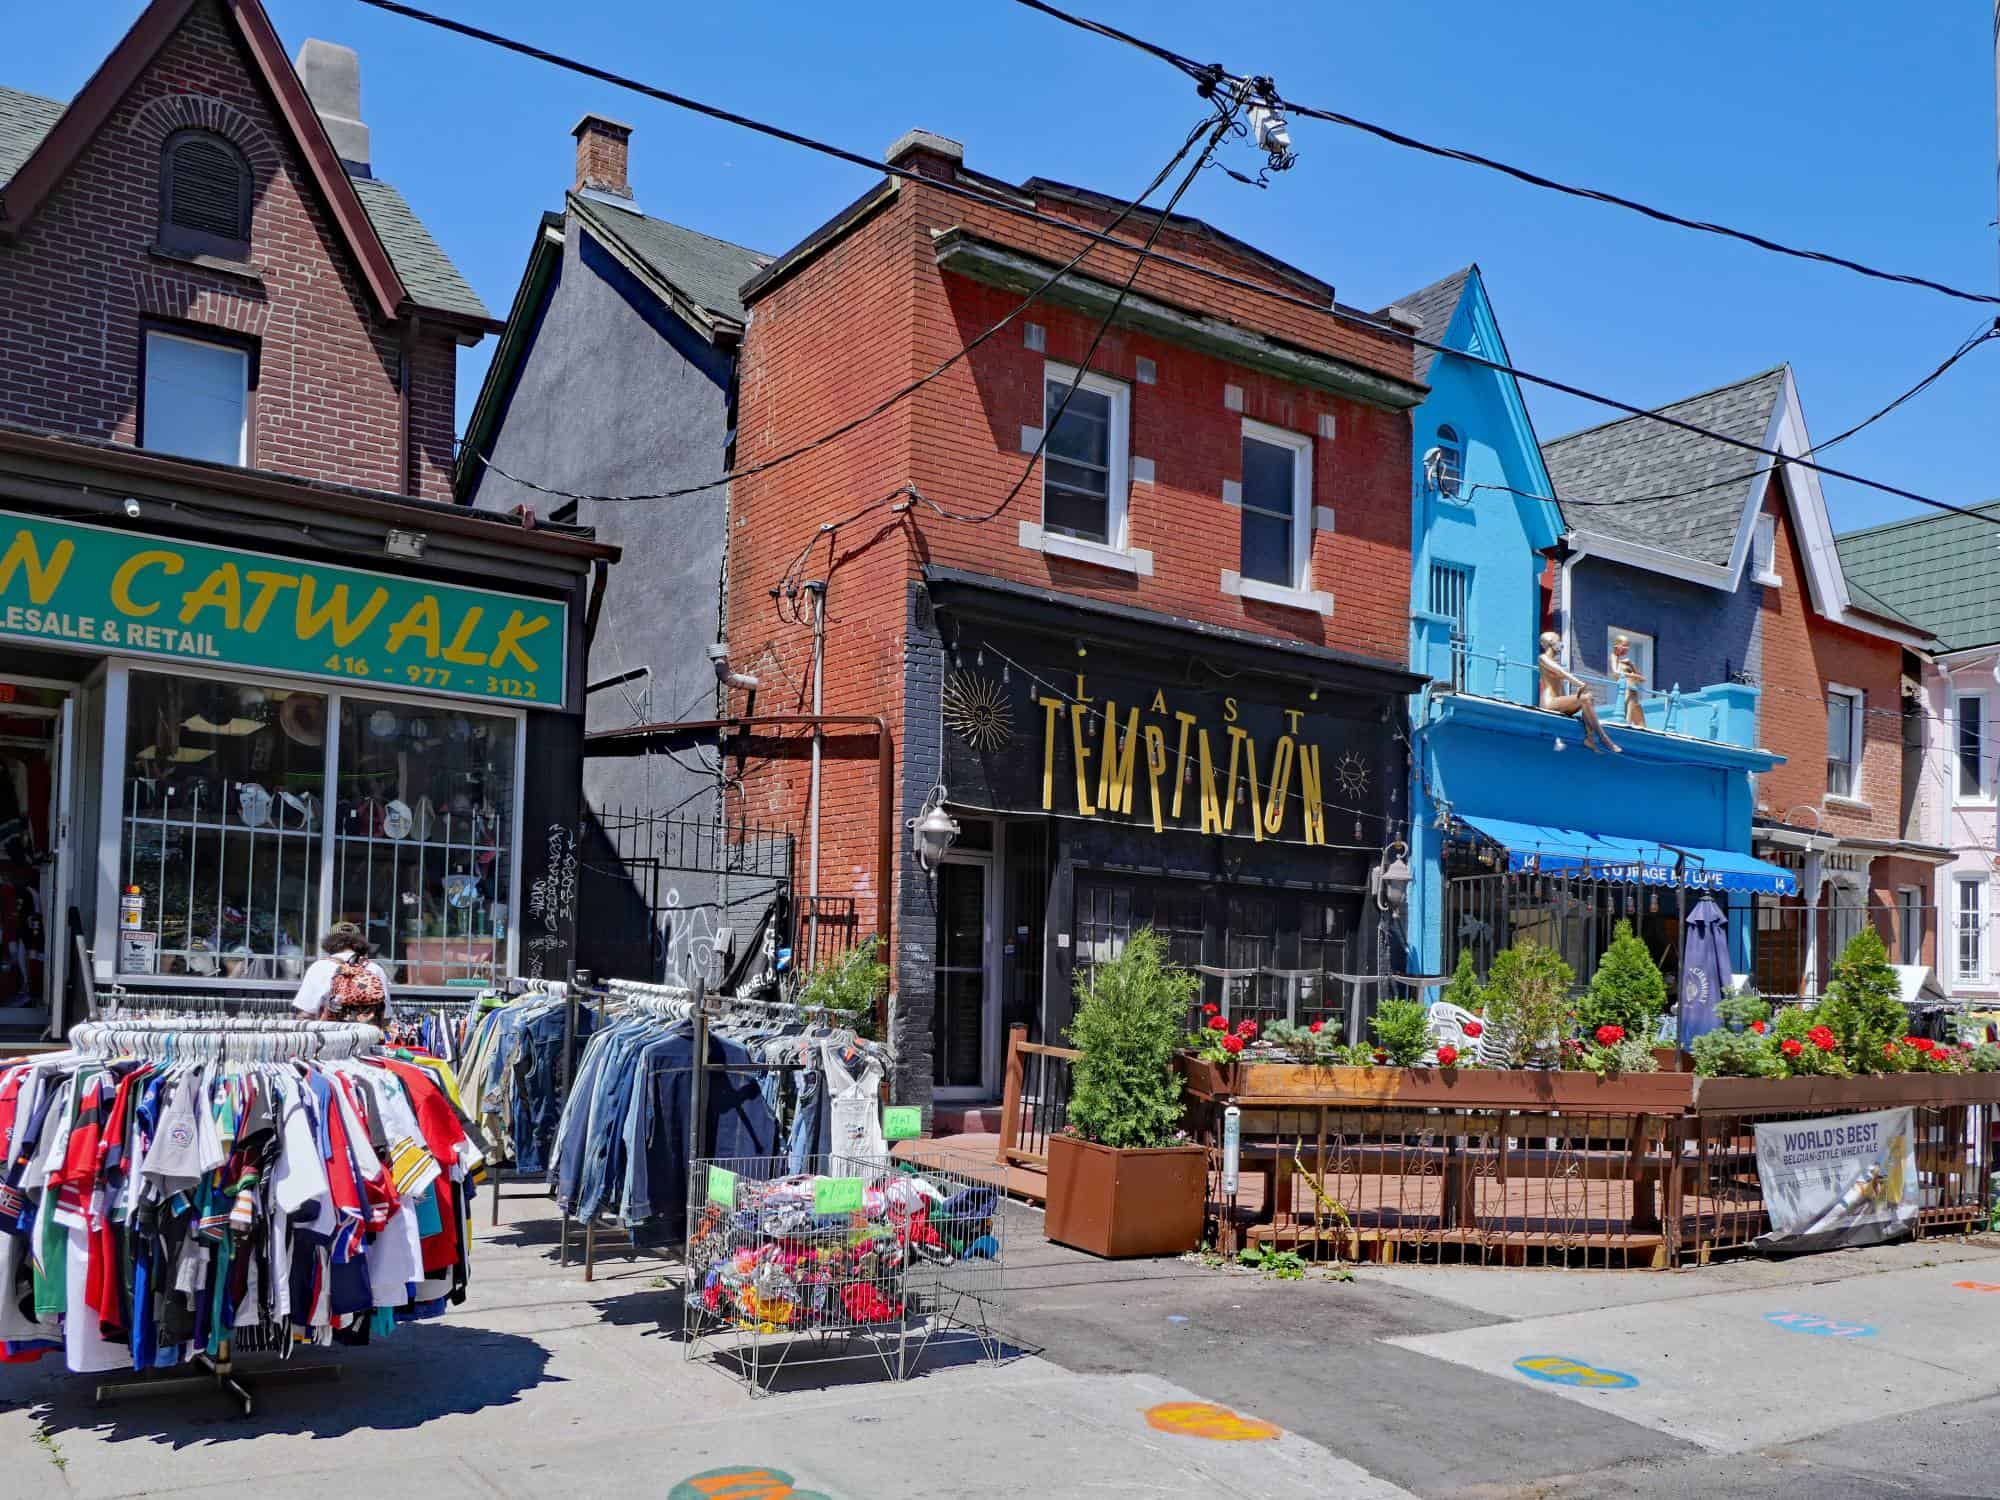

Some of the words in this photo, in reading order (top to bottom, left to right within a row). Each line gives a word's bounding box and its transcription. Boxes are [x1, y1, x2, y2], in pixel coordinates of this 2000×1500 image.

[110, 550, 550, 673] CATWALK
[102, 620, 120, 642] &
[127, 623, 219, 657] RETAIL
[324, 654, 369, 676] 416
[406, 663, 451, 686] 977
[487, 676, 537, 698] 3122
[1076, 673, 1304, 735] LAST
[1039, 697, 1326, 846] TEMPTATION
[1523, 855, 1535, 868] 14
[1775, 877, 1785, 890] 14
[1784, 1128, 1844, 1151] WORLD'S
[1848, 1123, 1879, 1144] BEST
[1841, 1145, 1866, 1158] WHEAT
[1866, 1143, 1878, 1154] ALE
